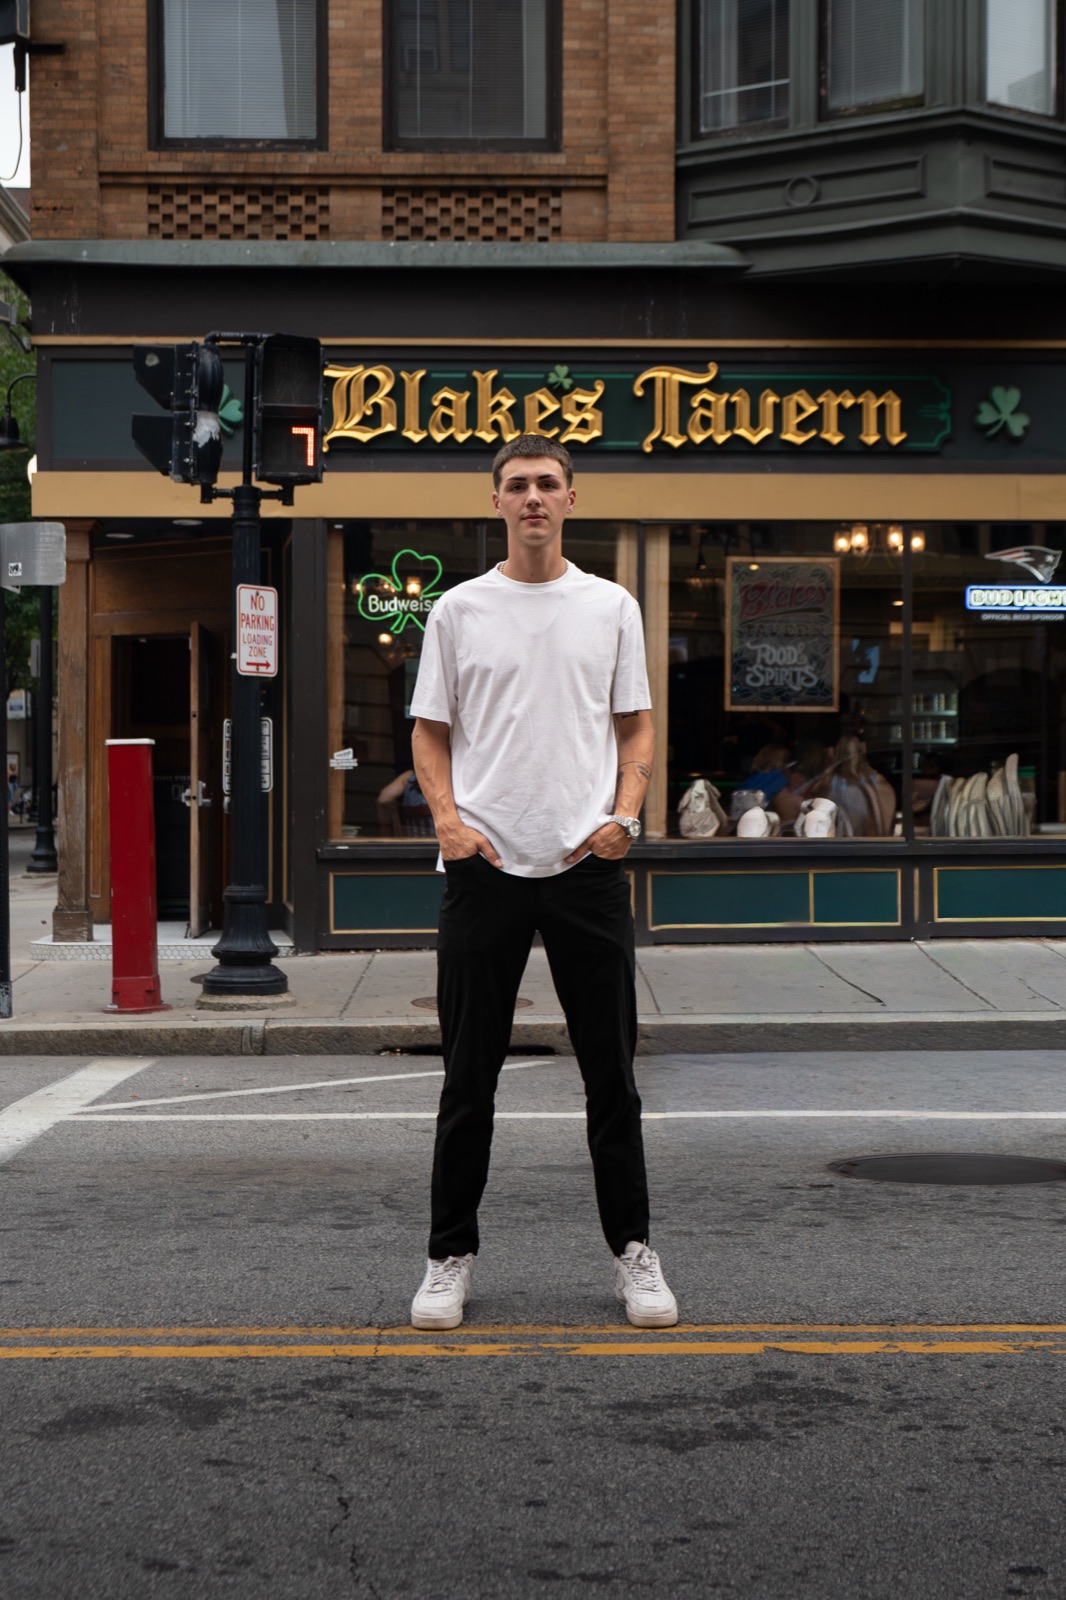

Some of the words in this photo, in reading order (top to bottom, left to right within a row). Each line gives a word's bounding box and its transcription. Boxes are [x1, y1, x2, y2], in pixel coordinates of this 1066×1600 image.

[322, 364, 604, 452] Blakes
[633, 362, 908, 452] Tavern
[250, 594, 265, 611] NO
[970, 589, 1014, 606] BUD
[240, 613, 275, 631] PARKING
[242, 633, 273, 646] LOADING
[248, 646, 267, 658] ZONE
[745, 664, 818, 691] SPIRITS
